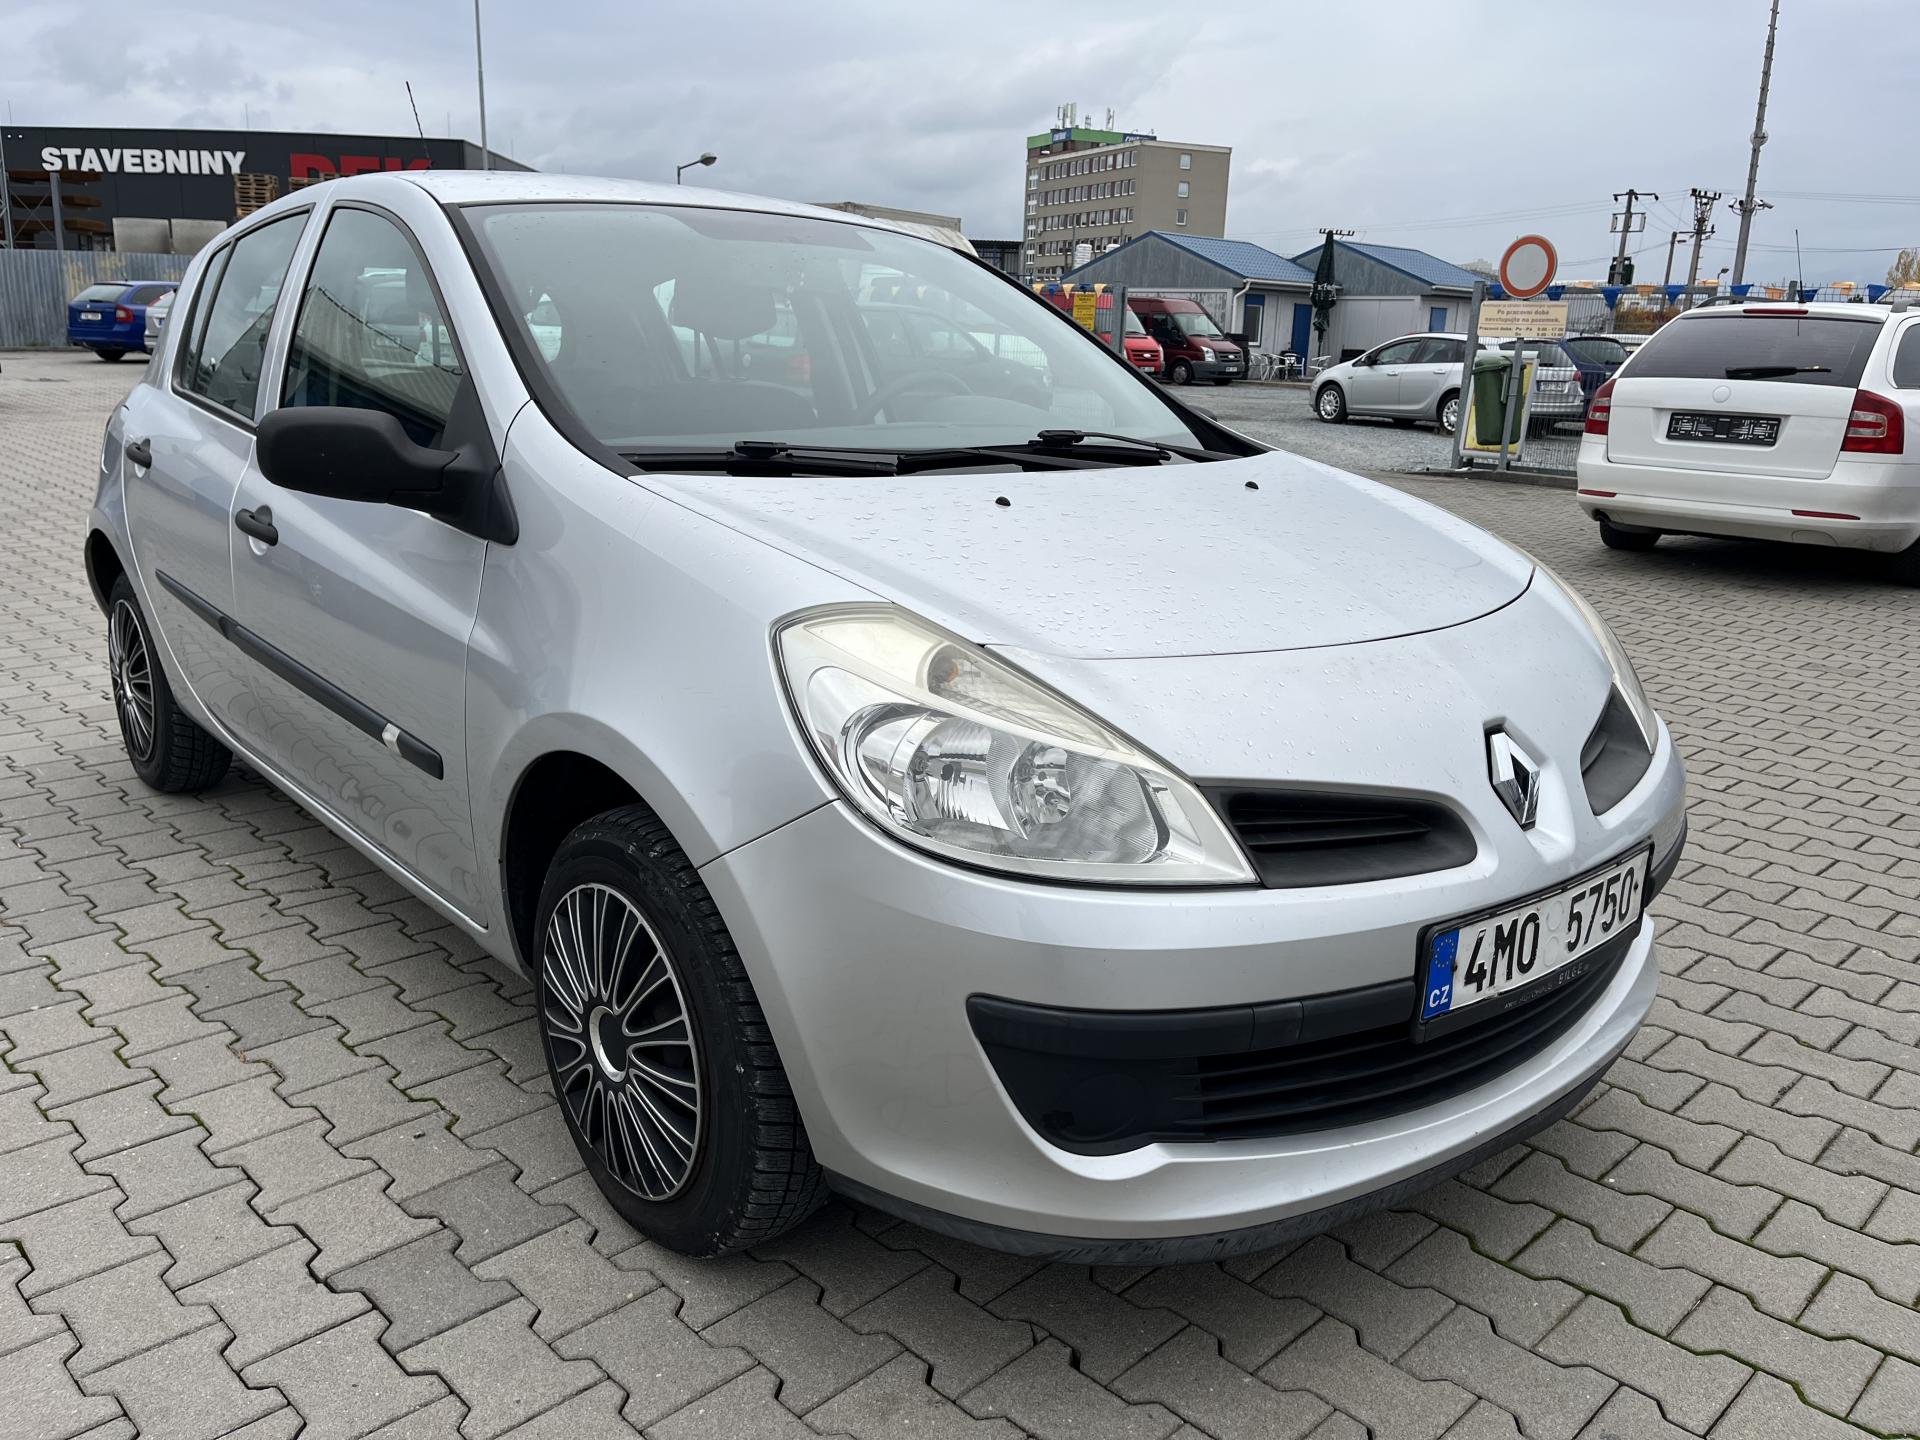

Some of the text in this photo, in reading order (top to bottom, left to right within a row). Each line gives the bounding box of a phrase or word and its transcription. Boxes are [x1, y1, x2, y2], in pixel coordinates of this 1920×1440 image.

[42, 147, 246, 175] STAVEBNINY
[1567, 867, 1634, 952] 5750
[1429, 984, 1449, 1008] CZ
